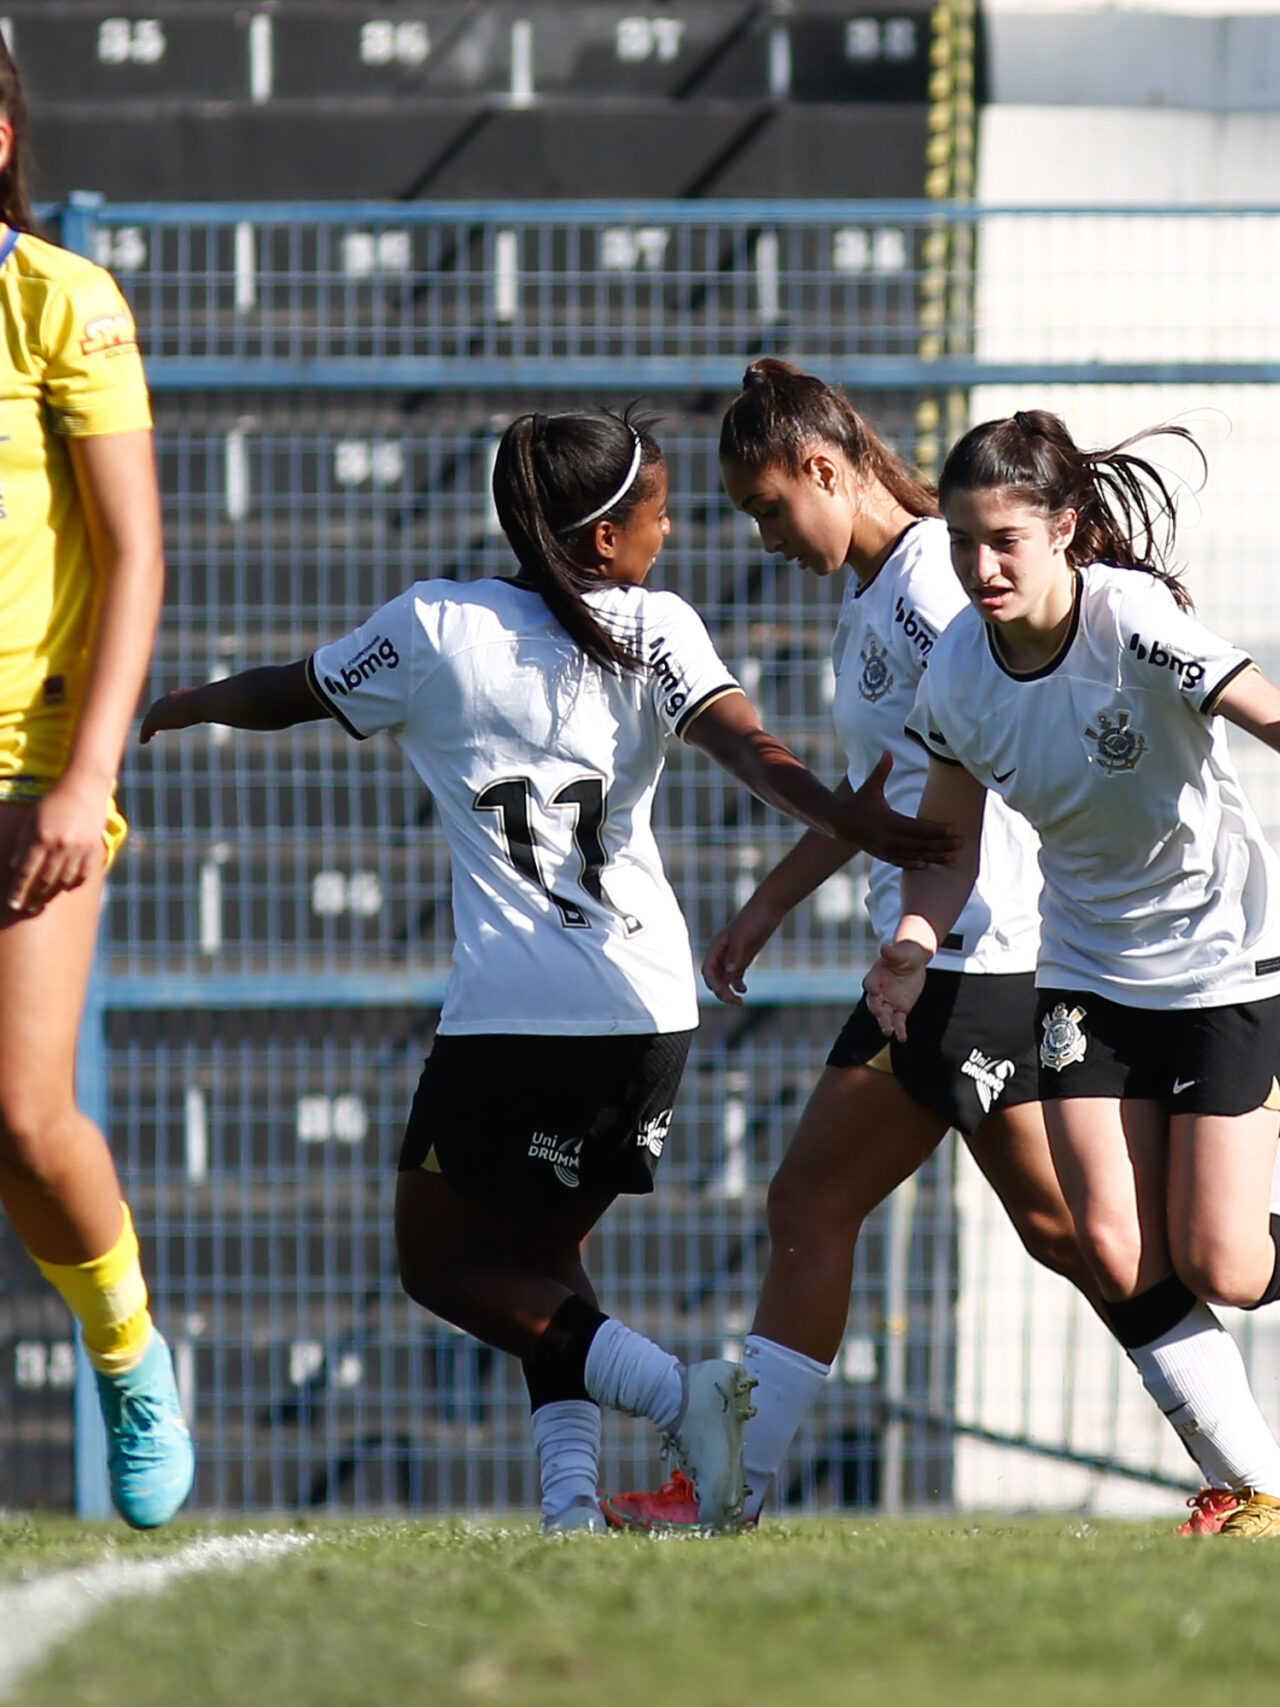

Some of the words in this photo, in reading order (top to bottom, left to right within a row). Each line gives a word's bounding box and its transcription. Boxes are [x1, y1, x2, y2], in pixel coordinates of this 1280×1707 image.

[340, 637, 399, 692] bmg
[1148, 640, 1206, 690] bmg
[472, 773, 646, 938] 11
[969, 1048, 992, 1067] Uni
[532, 1131, 558, 1148] Uni
